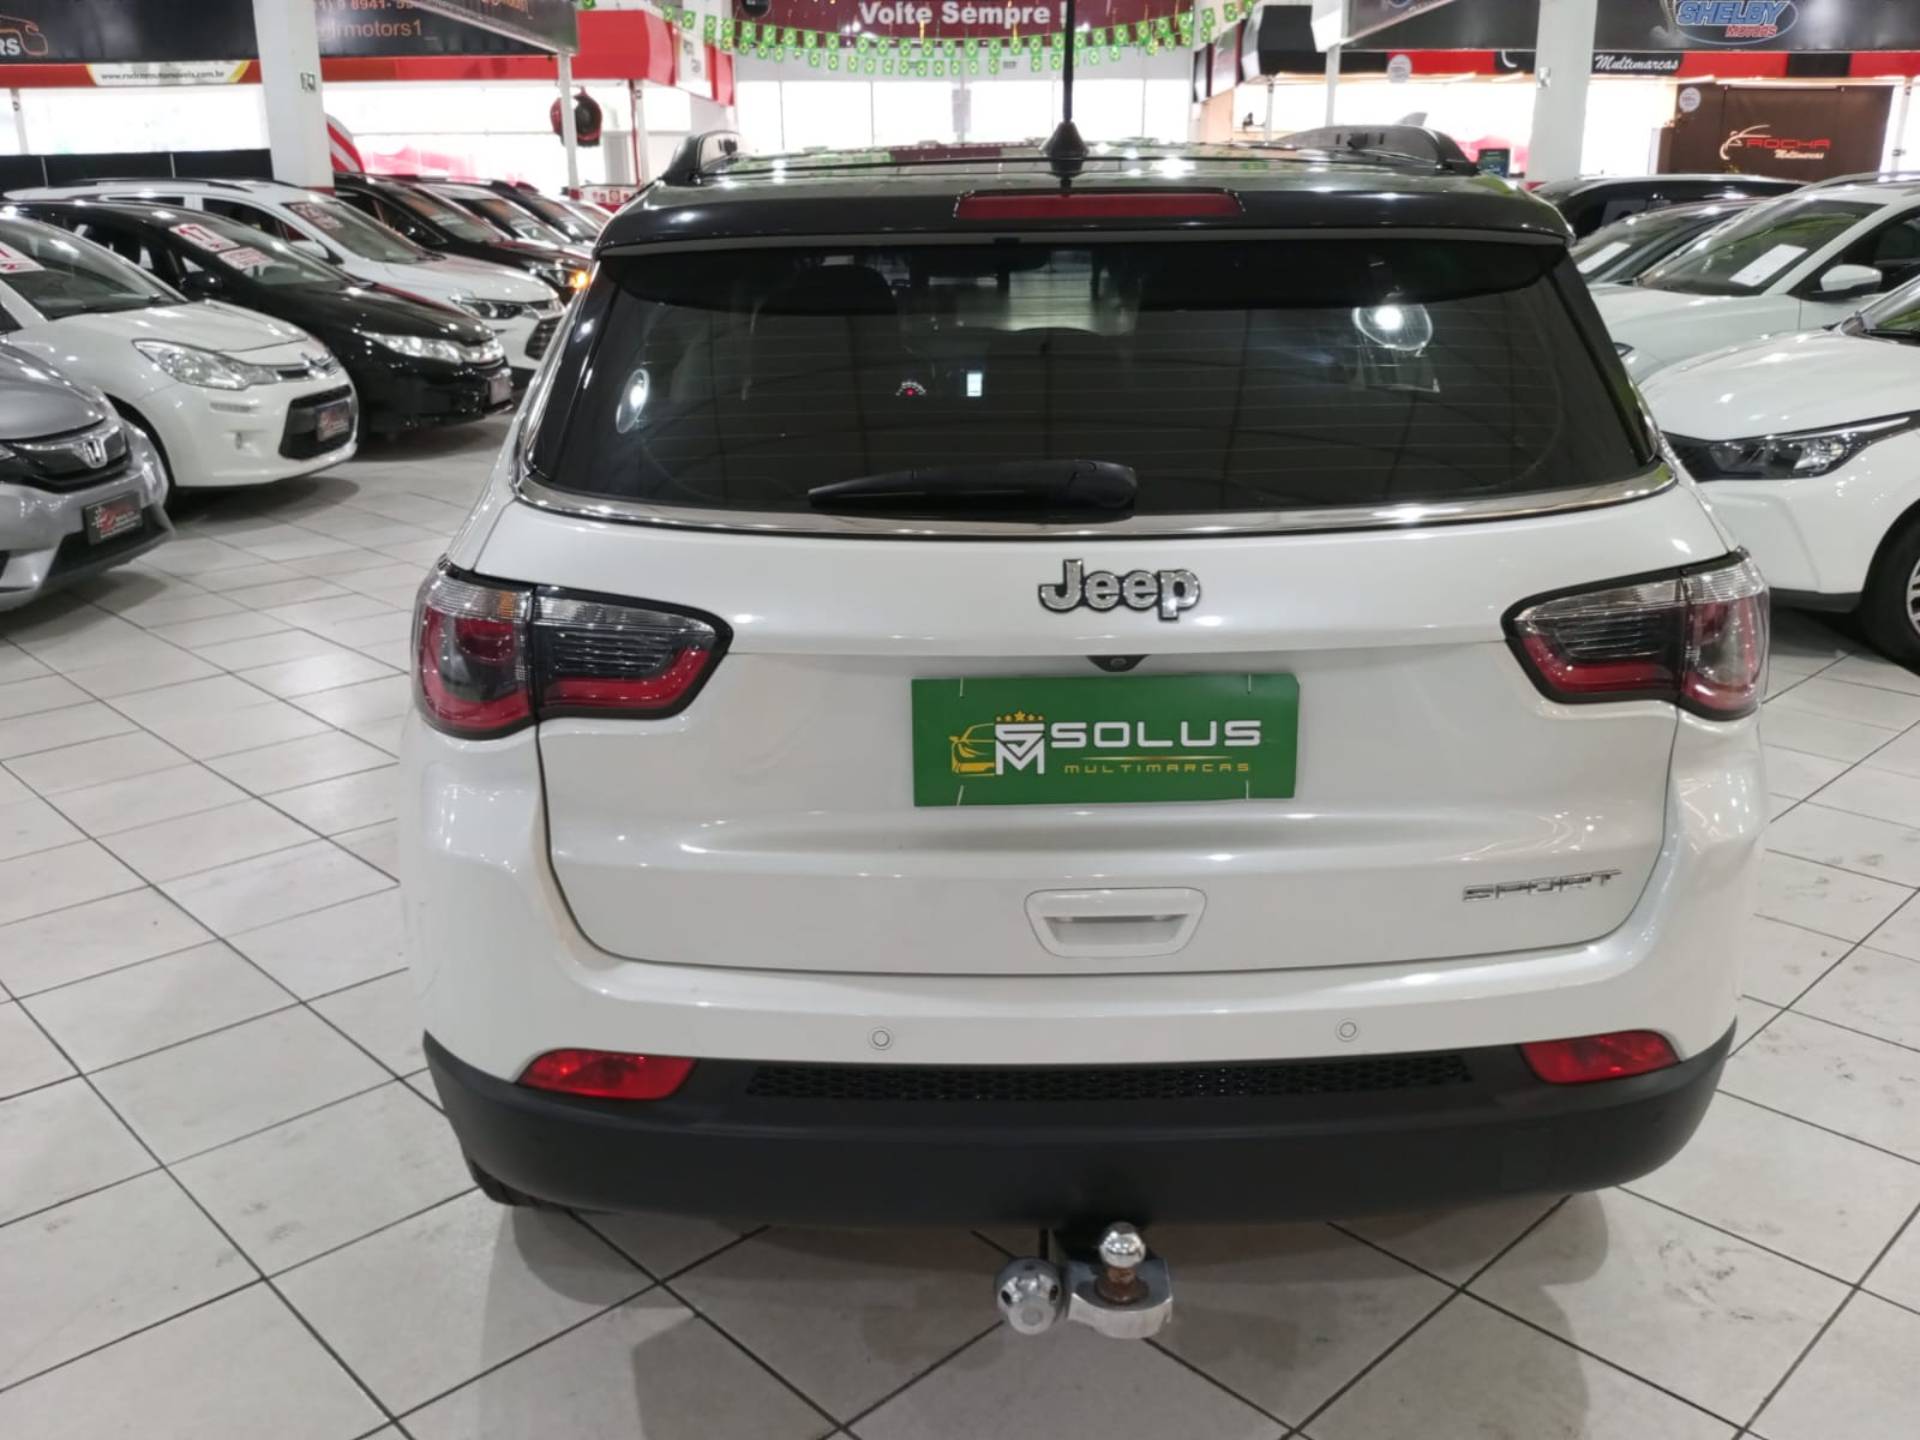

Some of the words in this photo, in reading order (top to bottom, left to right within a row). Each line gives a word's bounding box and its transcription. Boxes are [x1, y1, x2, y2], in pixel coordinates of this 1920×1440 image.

[860, 3, 933, 24] Volte
[941, 5, 1050, 29] Sempre
[1676, 0, 1788, 26] SHELBY
[1595, 54, 1679, 71] Multimarcas
[1746, 139, 1832, 149] ROCHA
[1038, 559, 1202, 622] Jeep
[1050, 720, 1262, 748] SOLUS
[1063, 763, 1250, 774] MULTIMARCAS
[1463, 869, 1622, 901] SPORT
